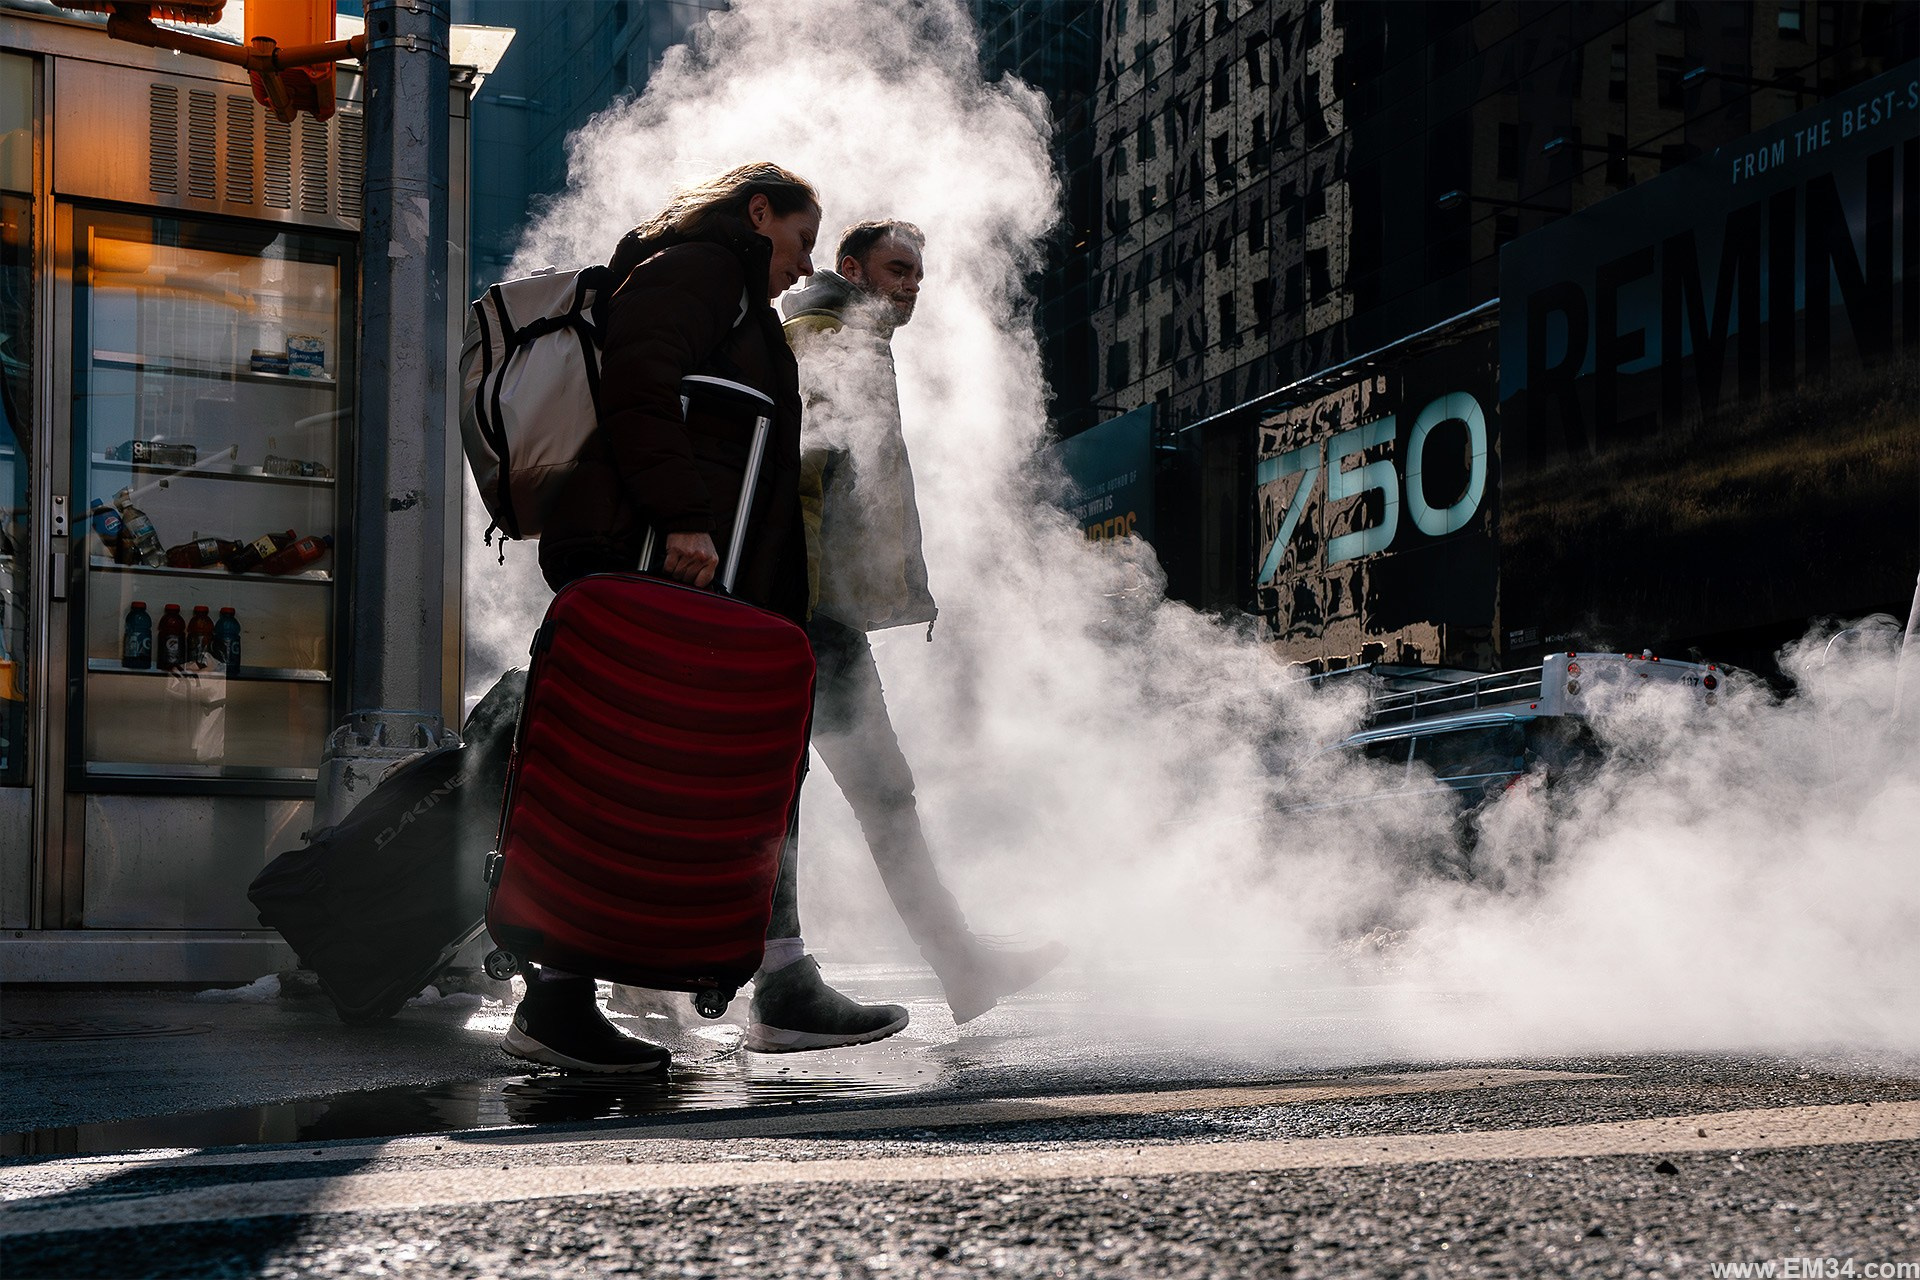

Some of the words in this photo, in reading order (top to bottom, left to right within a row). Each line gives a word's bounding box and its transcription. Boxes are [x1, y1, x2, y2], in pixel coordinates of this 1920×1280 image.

[1732, 137, 1785, 185] FROM
[1795, 117, 1831, 158] THE
[1104, 494, 1113, 511] US
[1257, 390, 1488, 585] 750
